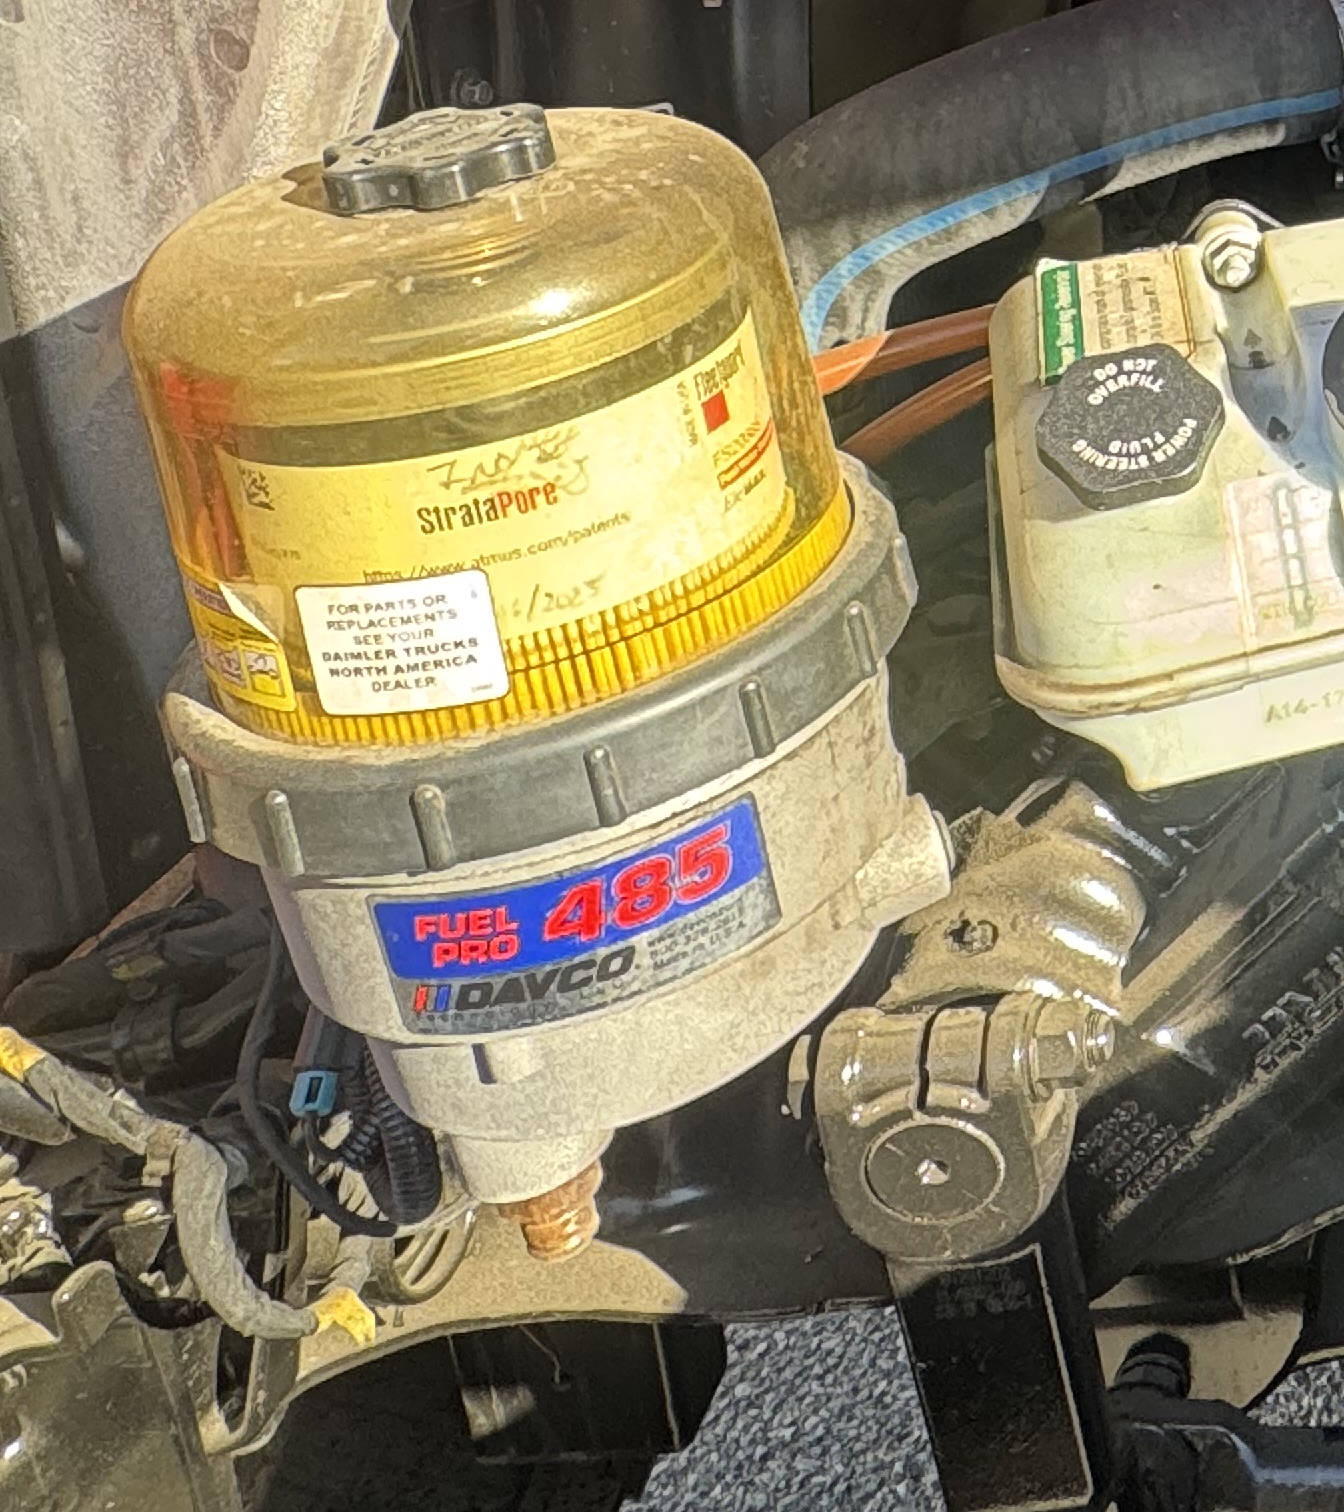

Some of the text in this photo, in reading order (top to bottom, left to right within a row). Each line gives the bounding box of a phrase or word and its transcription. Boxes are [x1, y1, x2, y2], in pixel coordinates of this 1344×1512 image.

[1092, 362, 1118, 383] DO
[1086, 372, 1166, 406] OVERFILL
[1071, 417, 1198, 470] POWER STEERING
[1108, 430, 1166, 455] FLUID
[416, 481, 559, 535] StrataPore
[327, 594, 448, 616] FOR PARTS OR
[326, 609, 458, 631] REPLACEMENTS
[321, 637, 480, 662] DAIMLER TRUCKS
[353, 628, 434, 646] SEE YOUR
[328, 654, 478, 678] NORTH AMERICA
[371, 676, 438, 693] DEALER
[413, 904, 520, 942] FUEL
[541, 820, 734, 943] 485
[431, 929, 522, 968] PRO
